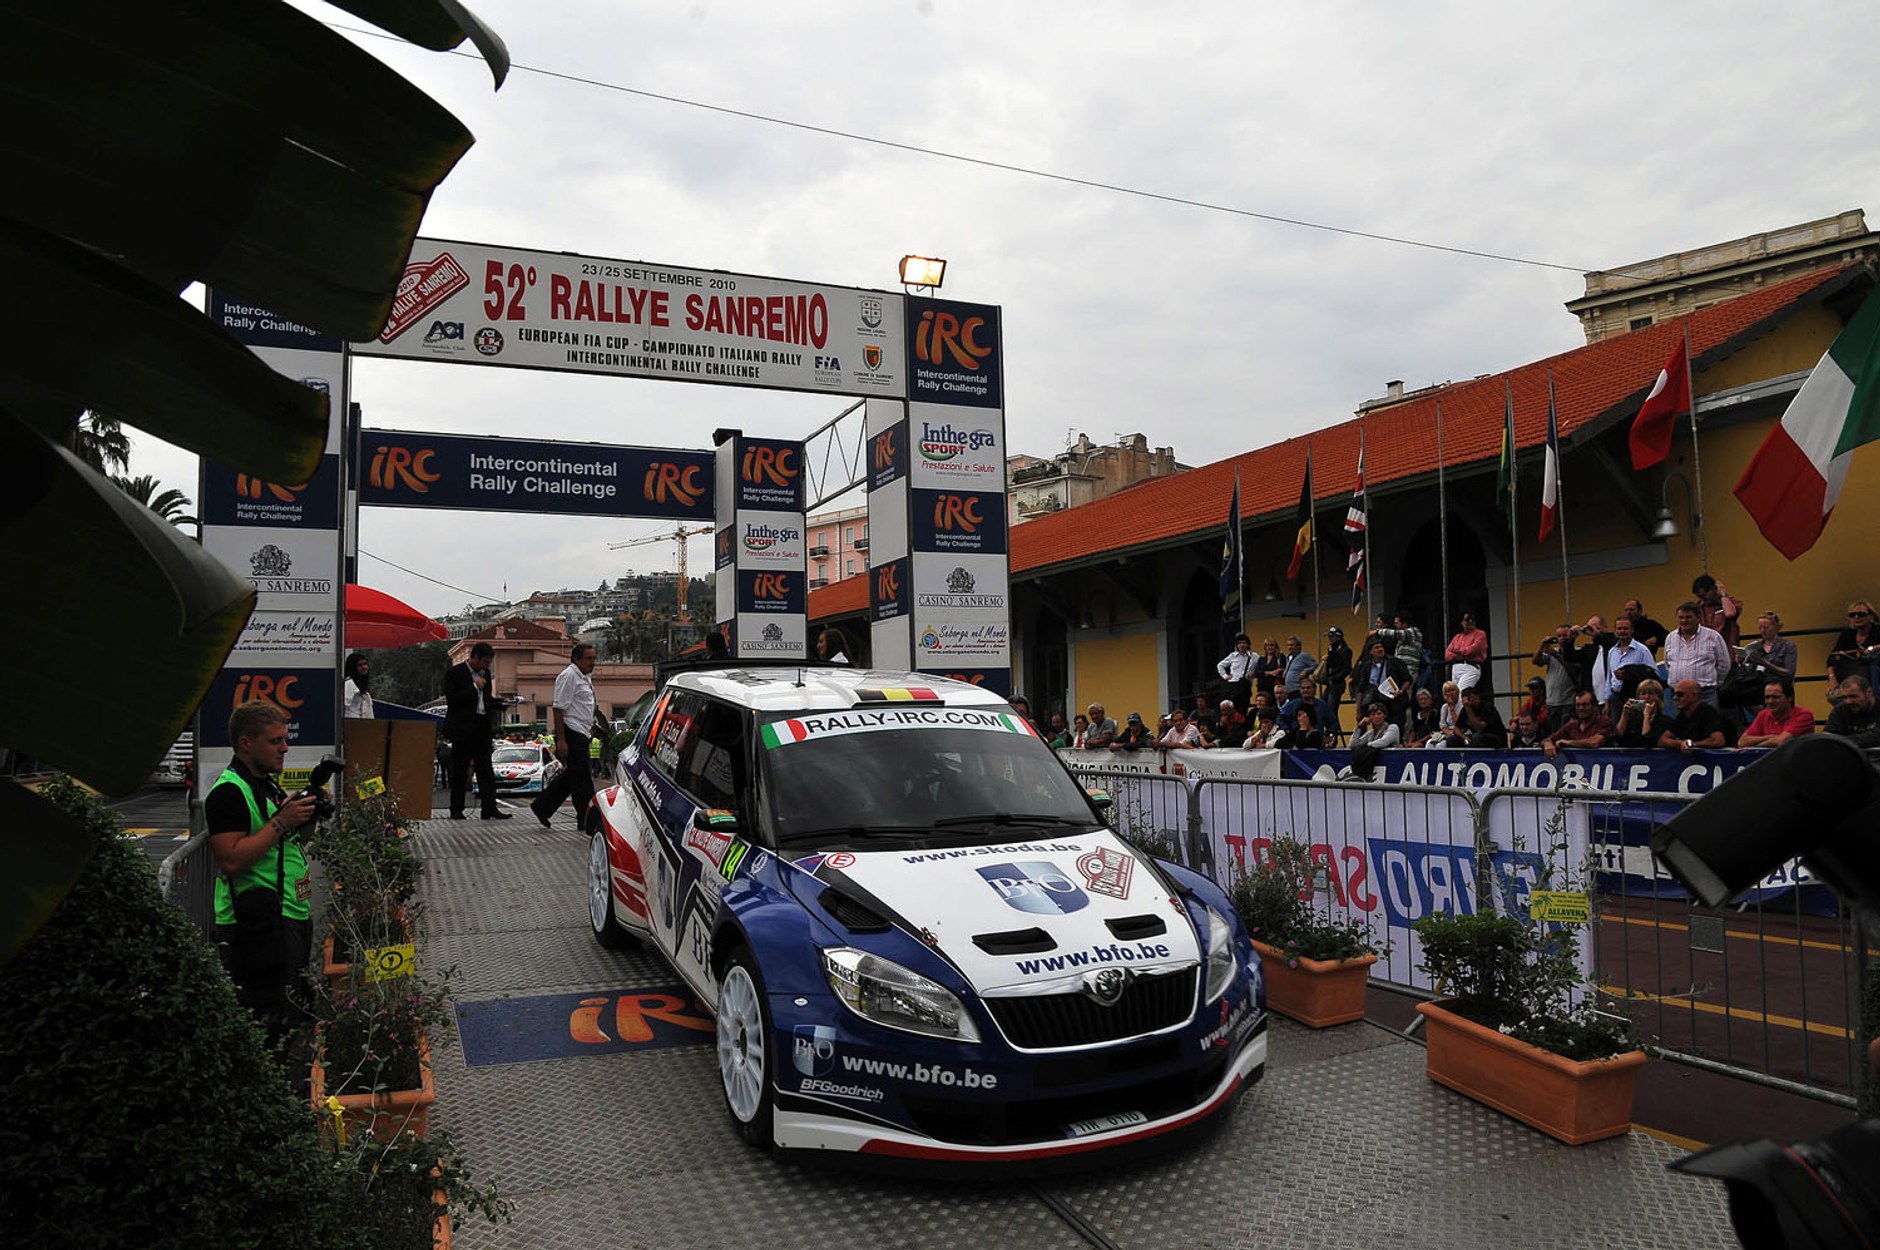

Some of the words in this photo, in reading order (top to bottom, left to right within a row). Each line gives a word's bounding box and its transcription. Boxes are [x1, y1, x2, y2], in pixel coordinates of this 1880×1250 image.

[418, 261, 459, 296] SANREMO
[582, 264, 621, 278] 23/25
[623, 267, 703, 287] SETTEMBRE
[709, 278, 736, 291] 2010
[551, 273, 669, 328] RALLYE
[685, 293, 828, 350] SANREMO
[224, 316, 256, 331] Rally
[518, 328, 580, 346] EUROPEAN
[584, 333, 601, 348] FIA
[606, 336, 629, 350] CUP
[643, 340, 715, 358] CAMPIONATO
[719, 347, 767, 363] ITALIANO
[772, 352, 802, 367] RALLY
[567, 350, 667, 371] INTERCONTINENTAL
[671, 360, 701, 373] RALLY
[705, 362, 760, 378] CHALLENGE
[917, 369, 988, 384] Intercontinental
[918, 379, 940, 391] Rally
[942, 382, 988, 396] Challenge
[923, 443, 966, 455] SPORT
[470, 453, 617, 477] Intercontinental
[922, 460, 962, 470] Prestazioni
[973, 463, 995, 473] Salute
[469, 474, 517, 495] Rally
[523, 477, 617, 499] Challenge
[743, 486, 794, 496] Intercontinental
[237, 502, 302, 512] Intercontinental
[743, 494, 760, 502] Rally
[761, 495, 794, 504] Challenge
[237, 511, 258, 520] Rally
[260, 512, 302, 522] Challenge
[746, 538, 778, 546] SPORT
[936, 540, 951, 548] Rally
[952, 540, 981, 548] Challenge
[266, 581, 331, 592] SANREMO
[959, 596, 1004, 607] SANREMO
[244, 616, 277, 637] eborga
[281, 617, 298, 632] nel
[300, 616, 332, 632] Mondo
[939, 625, 969, 642] Seborga
[971, 626, 985, 638] nel
[984, 625, 1007, 638] Mondo
[805, 711, 1003, 733] RALLY-IRC.COM
[1398, 762, 1650, 792] AUTOMOBILE
[722, 842, 746, 881] 14
[902, 842, 1082, 864] www.skoda.be
[1548, 908, 1588, 917] ALLAVENA
[1015, 942, 1171, 976] www.bfo.be
[842, 1055, 998, 1089] www.bfo.be
[800, 1078, 885, 1100] BFGoodrich
